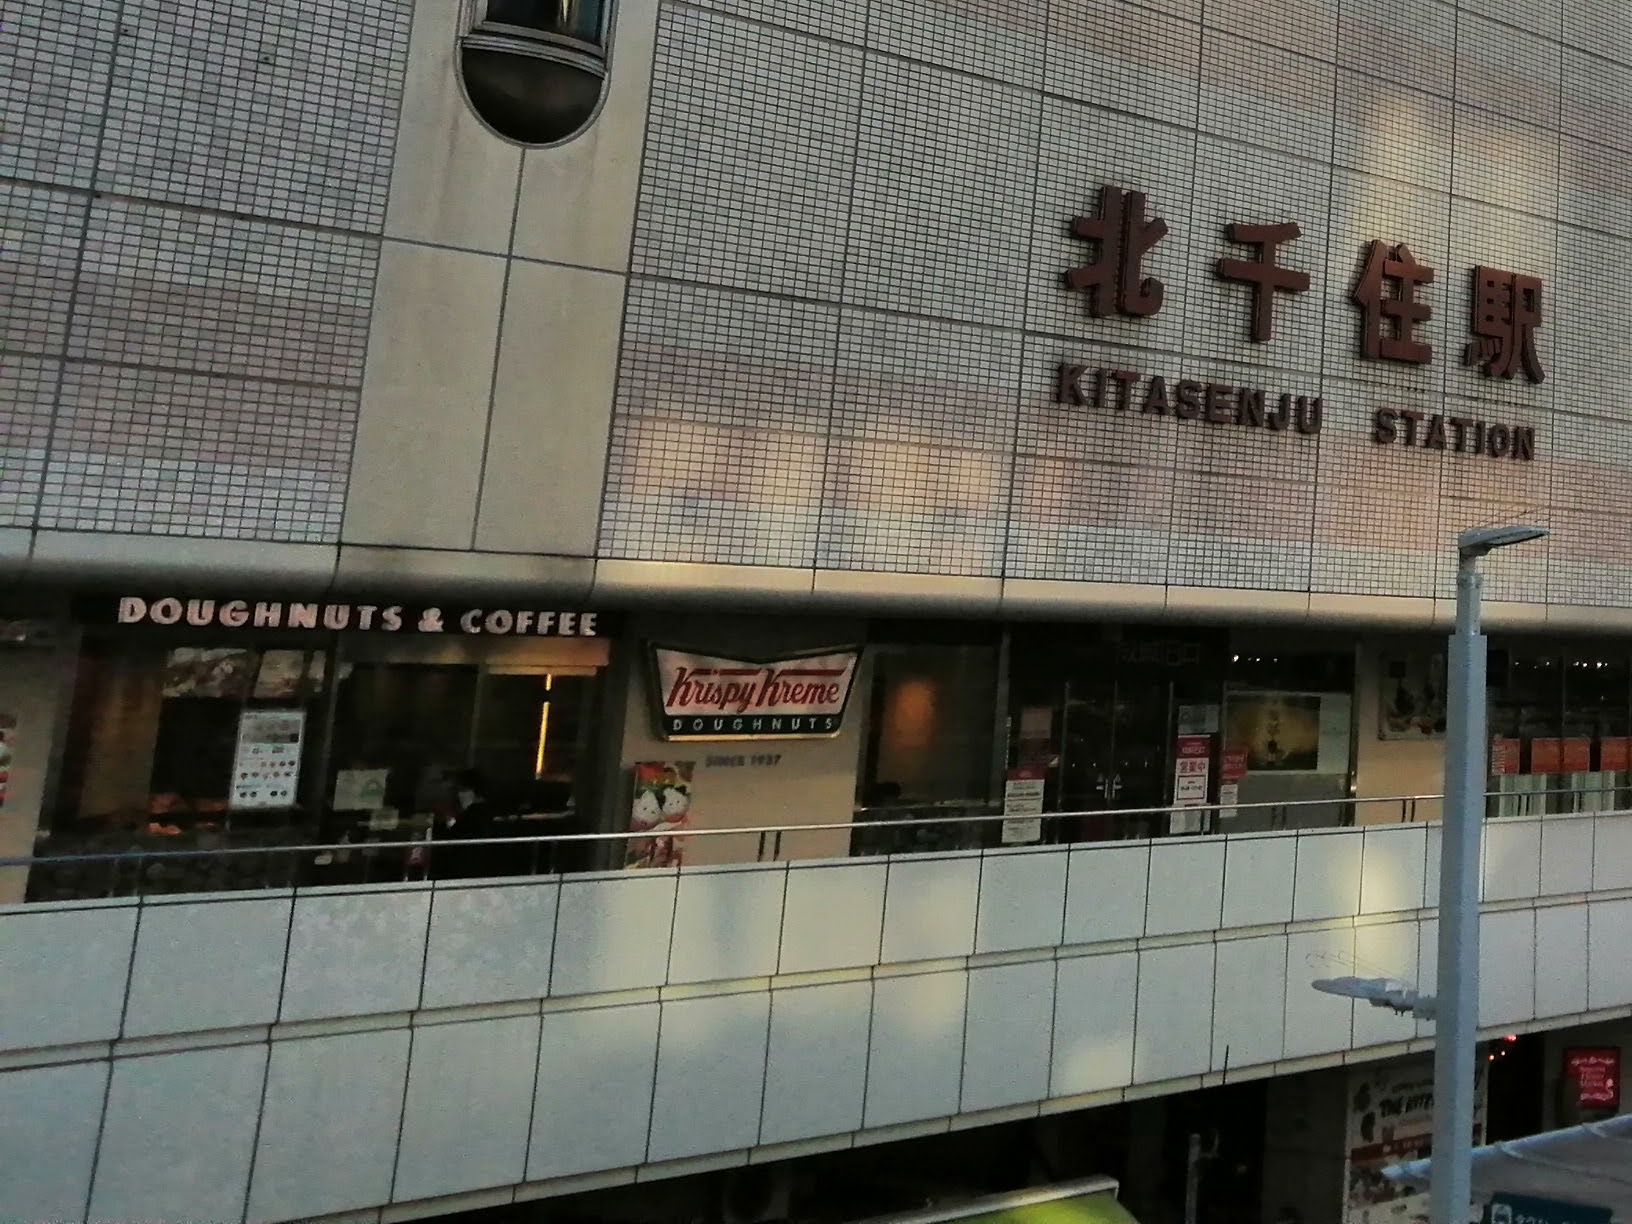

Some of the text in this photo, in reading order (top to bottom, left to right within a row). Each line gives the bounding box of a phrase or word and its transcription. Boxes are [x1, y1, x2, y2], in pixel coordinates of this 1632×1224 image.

[1062, 183, 1546, 385] 北千住駅
[1056, 362, 1536, 461] KITASENJU STATION
[117, 596, 598, 637] DOUGHNUTS & COFFEE
[666, 666, 848, 714] Krispy Kreme
[672, 717, 833, 732] DOUGHNUTS
